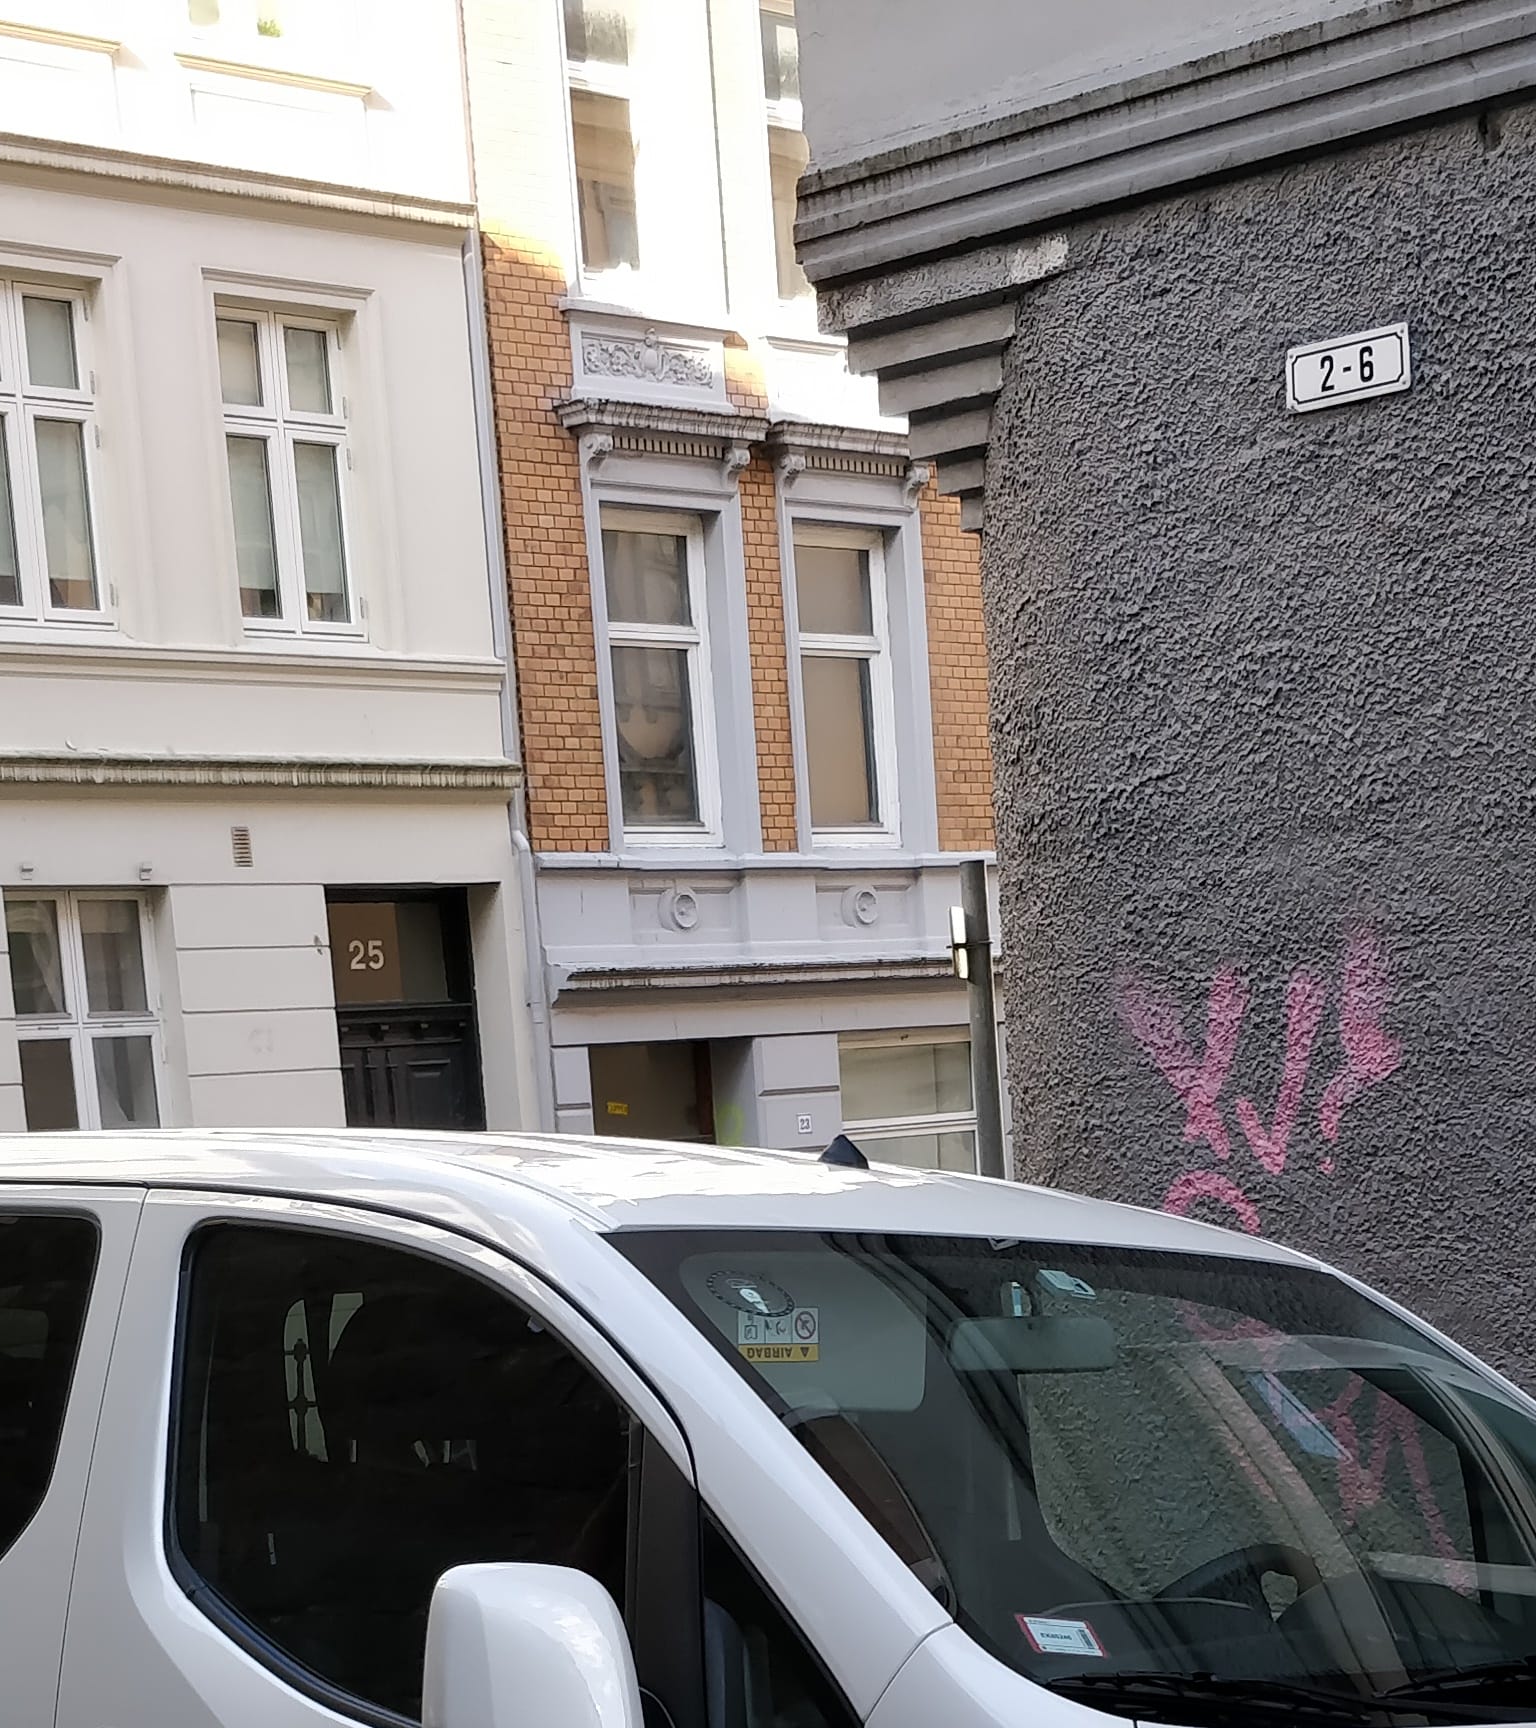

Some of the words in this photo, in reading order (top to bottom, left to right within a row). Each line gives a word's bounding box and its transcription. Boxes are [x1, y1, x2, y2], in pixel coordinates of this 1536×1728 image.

[348, 940, 385, 970] 25
[799, 1118, 811, 1130] 23
[746, 1346, 793, 1359] AIRBAG
